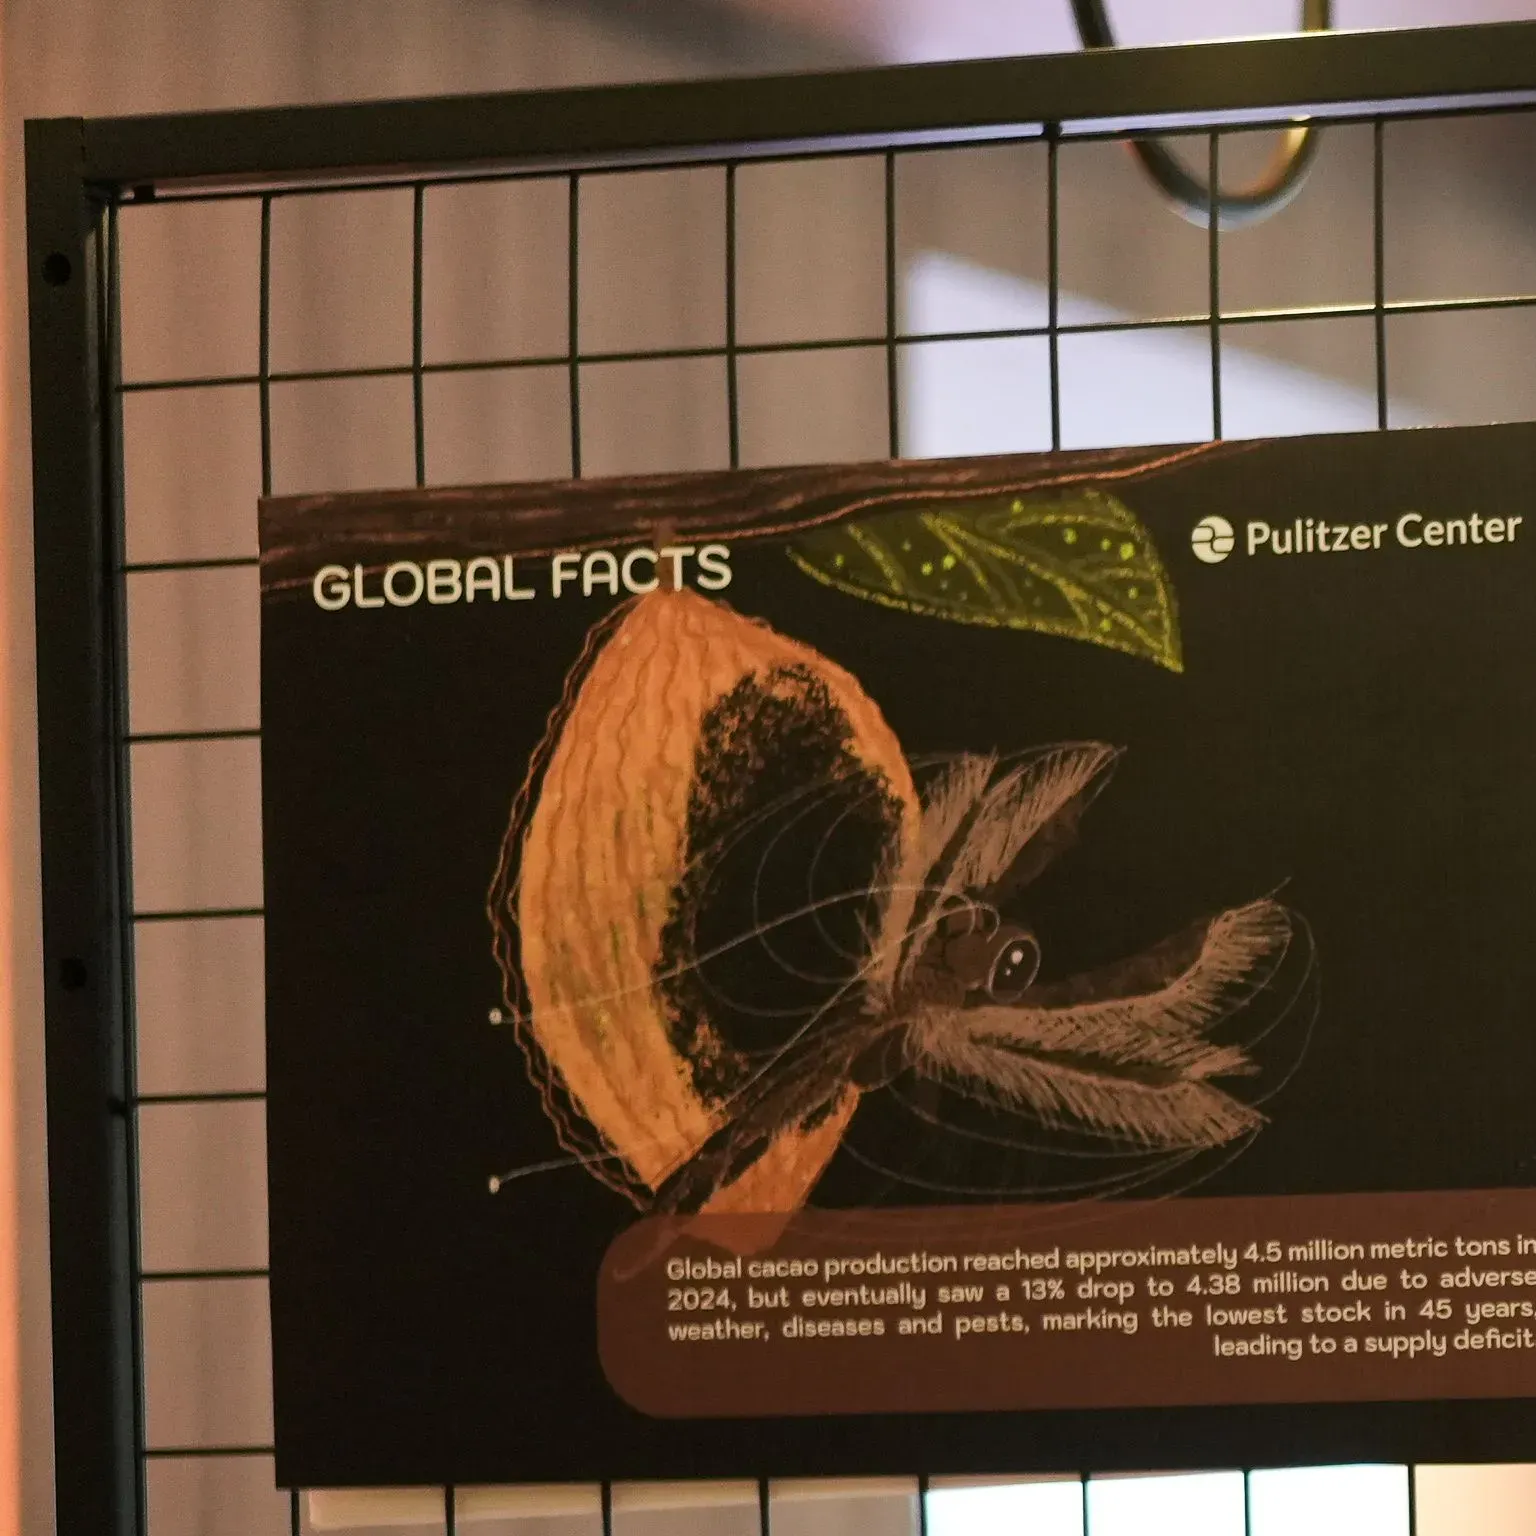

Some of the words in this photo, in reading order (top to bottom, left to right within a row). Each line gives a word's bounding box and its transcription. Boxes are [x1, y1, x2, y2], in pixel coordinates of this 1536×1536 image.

[1247, 518, 1388, 556] Pulitzer
[1396, 513, 1523, 548] Center
[313, 554, 536, 610] GLOBAL
[551, 544, 732, 598] FACTS
[666, 1256, 742, 1281] Global
[747, 1259, 819, 1278] cacao
[824, 1251, 958, 1283] production
[963, 1246, 1060, 1271] reached
[1066, 1243, 1238, 1275] approximately
[1243, 1241, 1283, 1263] 4.5
[1288, 1238, 1365, 1262] million
[1370, 1237, 1448, 1259] metric
[1454, 1236, 1511, 1257] tons
[667, 1287, 737, 1312] 2024,
[748, 1285, 790, 1309] but
[801, 1280, 926, 1310] eventually
[938, 1286, 984, 1303] saw
[995, 1285, 1010, 1302] a
[1021, 1278, 1065, 1301] 13%
[1077, 1277, 1135, 1305] drop
[1146, 1276, 1174, 1297] to
[1186, 1273, 1241, 1295] 4.38
[1253, 1271, 1329, 1294] million
[1341, 1269, 1388, 1291] due
[1399, 1269, 1428, 1290] to
[668, 1317, 770, 1341] weather,
[782, 1315, 885, 1338] diseases
[898, 1311, 943, 1335] and
[955, 1311, 1030, 1340] pests,
[1042, 1307, 1138, 1335] marking
[1151, 1305, 1193, 1328] the
[1206, 1303, 1288, 1326] lowest
[1301, 1299, 1371, 1323] stock
[1384, 1300, 1406, 1321] in
[1419, 1298, 1453, 1320] 45
[1214, 1333, 1303, 1361] leading
[1309, 1333, 1337, 1354] to
[1343, 1337, 1358, 1353] a
[1364, 1329, 1447, 1359] supply
